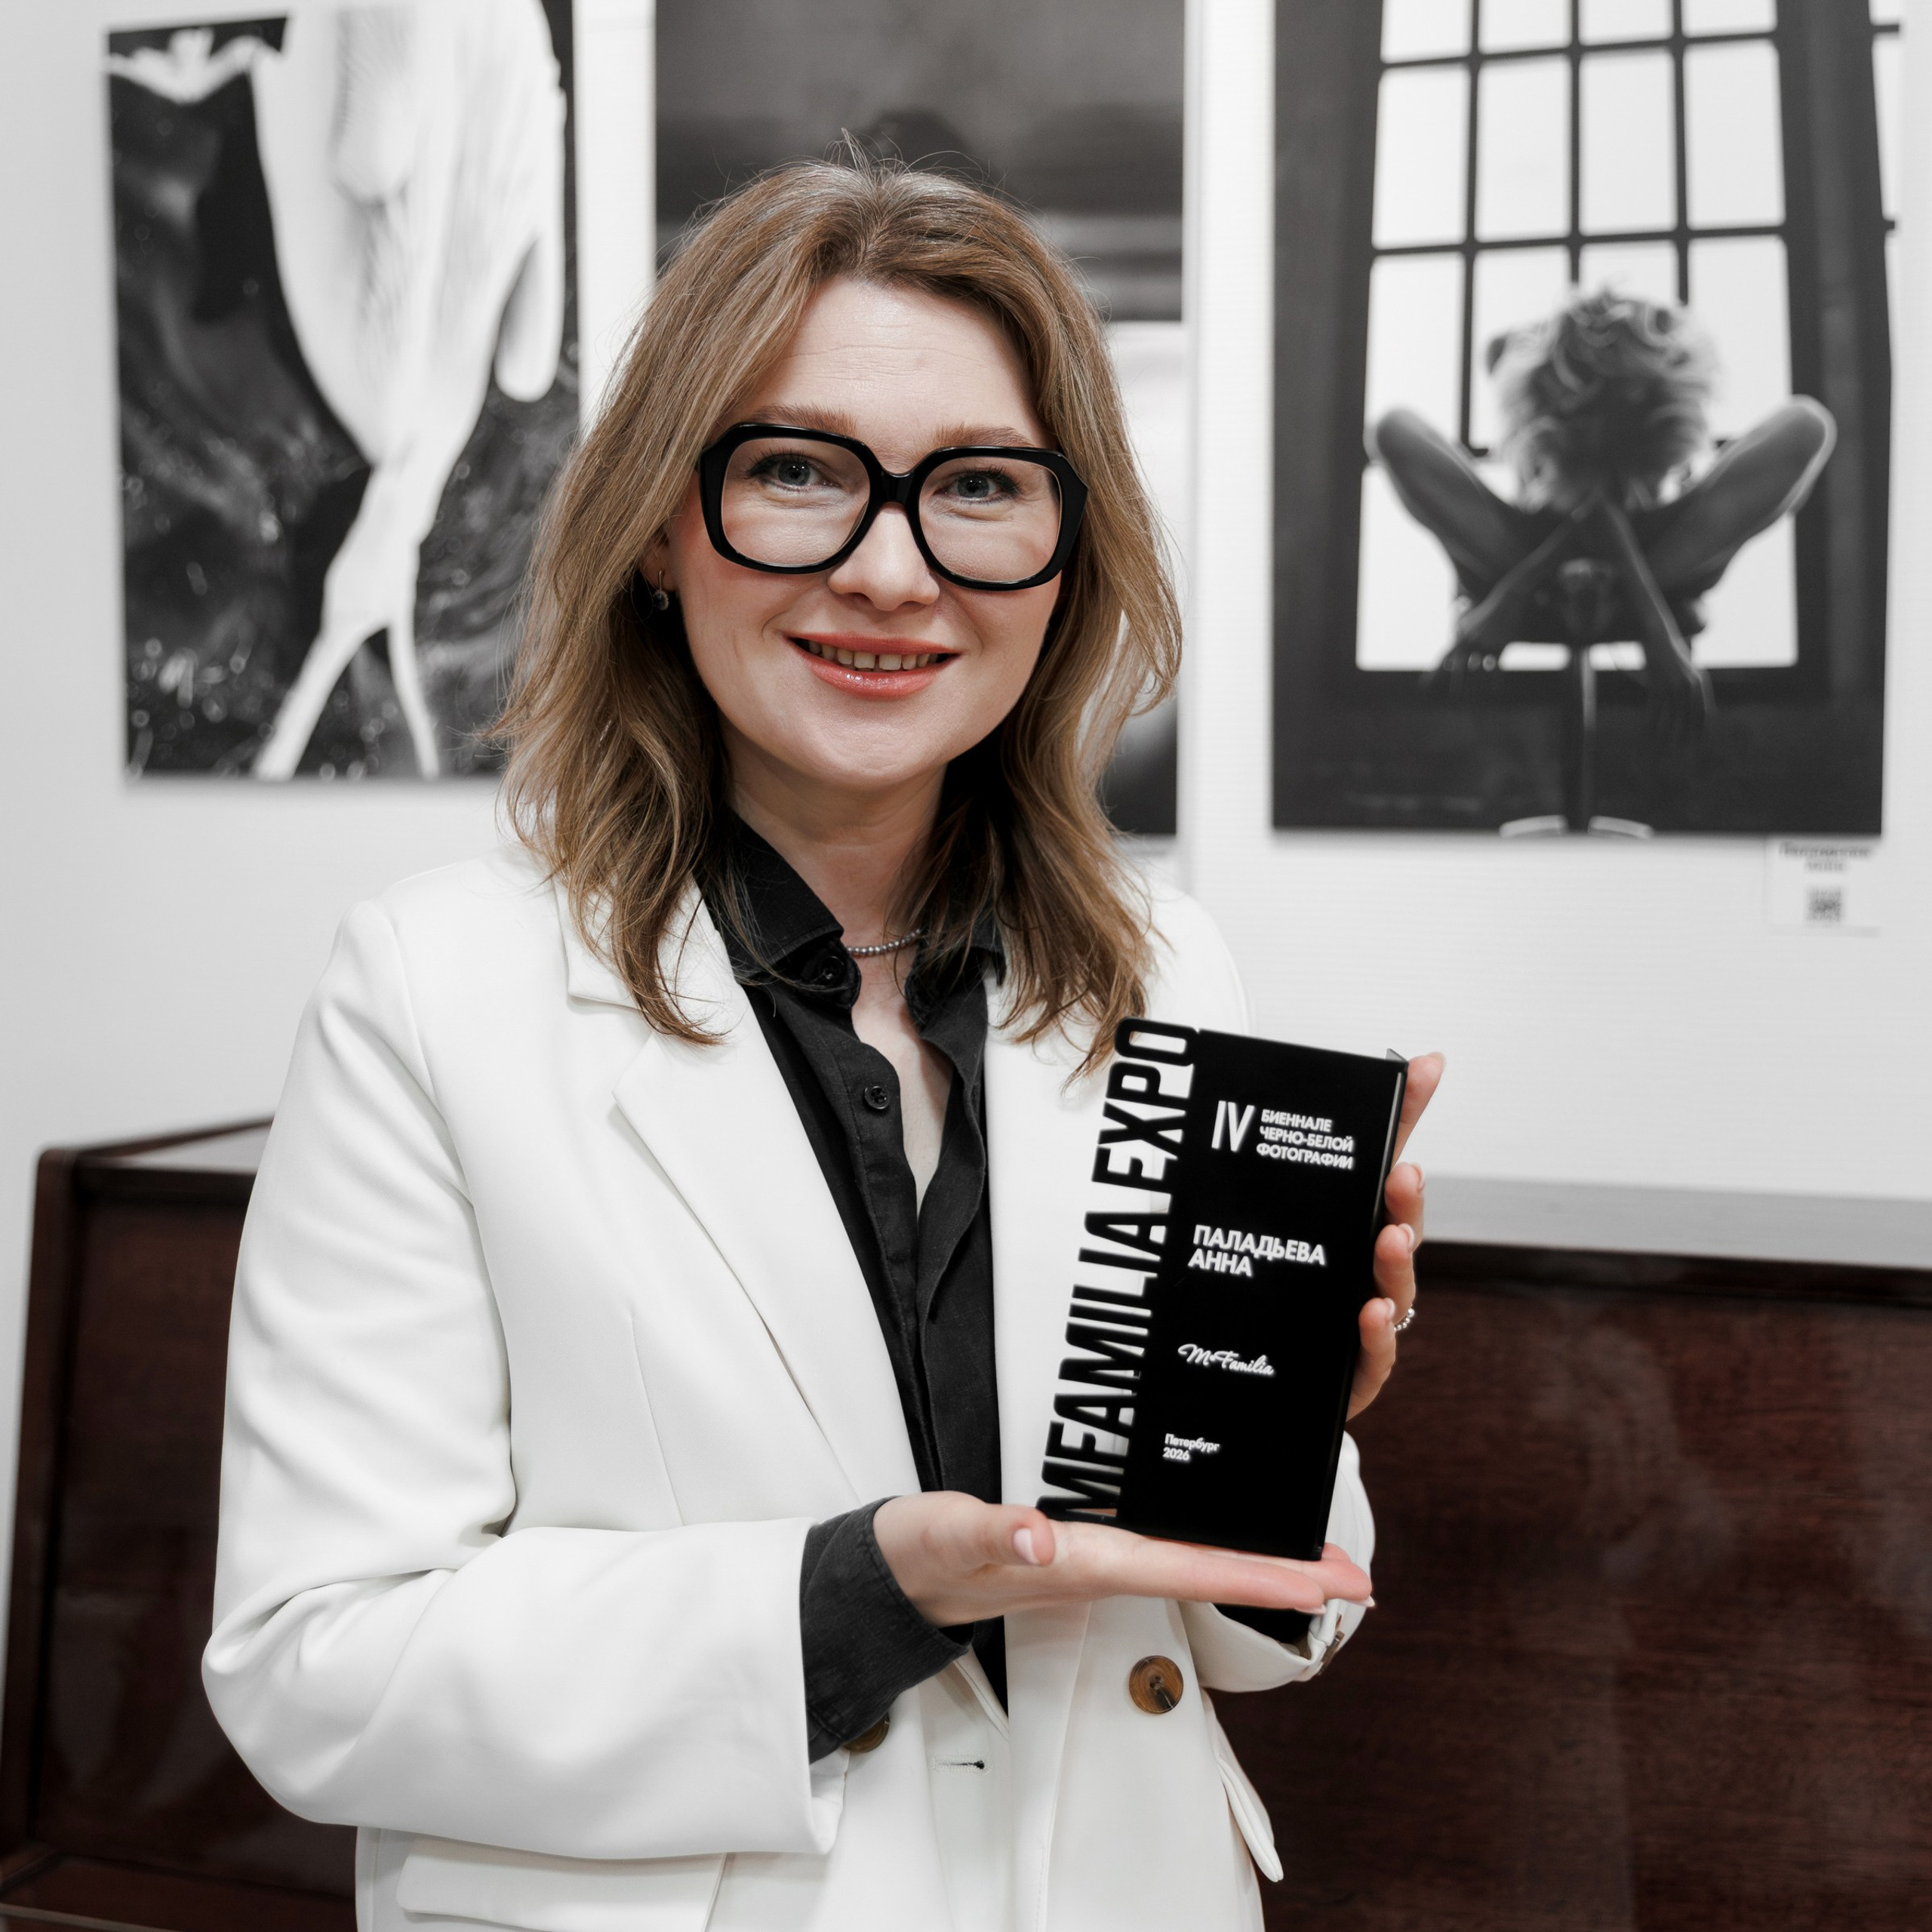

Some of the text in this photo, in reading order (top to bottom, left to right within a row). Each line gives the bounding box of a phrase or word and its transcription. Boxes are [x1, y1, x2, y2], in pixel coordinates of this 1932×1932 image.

[1091, 1017, 1200, 1192] EXPO
[1211, 1100, 1256, 1152] IV
[1261, 1109, 1333, 1132] БИЕННАЛЕ
[1260, 1125, 1354, 1152] ЧЕРНО-БЕЛОЙ
[1257, 1143, 1354, 1170] ФОТОГРАФИИ
[1192, 1224, 1326, 1266] ПАЛАДЬЕВА
[1188, 1248, 1253, 1277] АННА
[1162, 1447, 1190, 1461] 2026
[1164, 1433, 1220, 1453] Петербург
